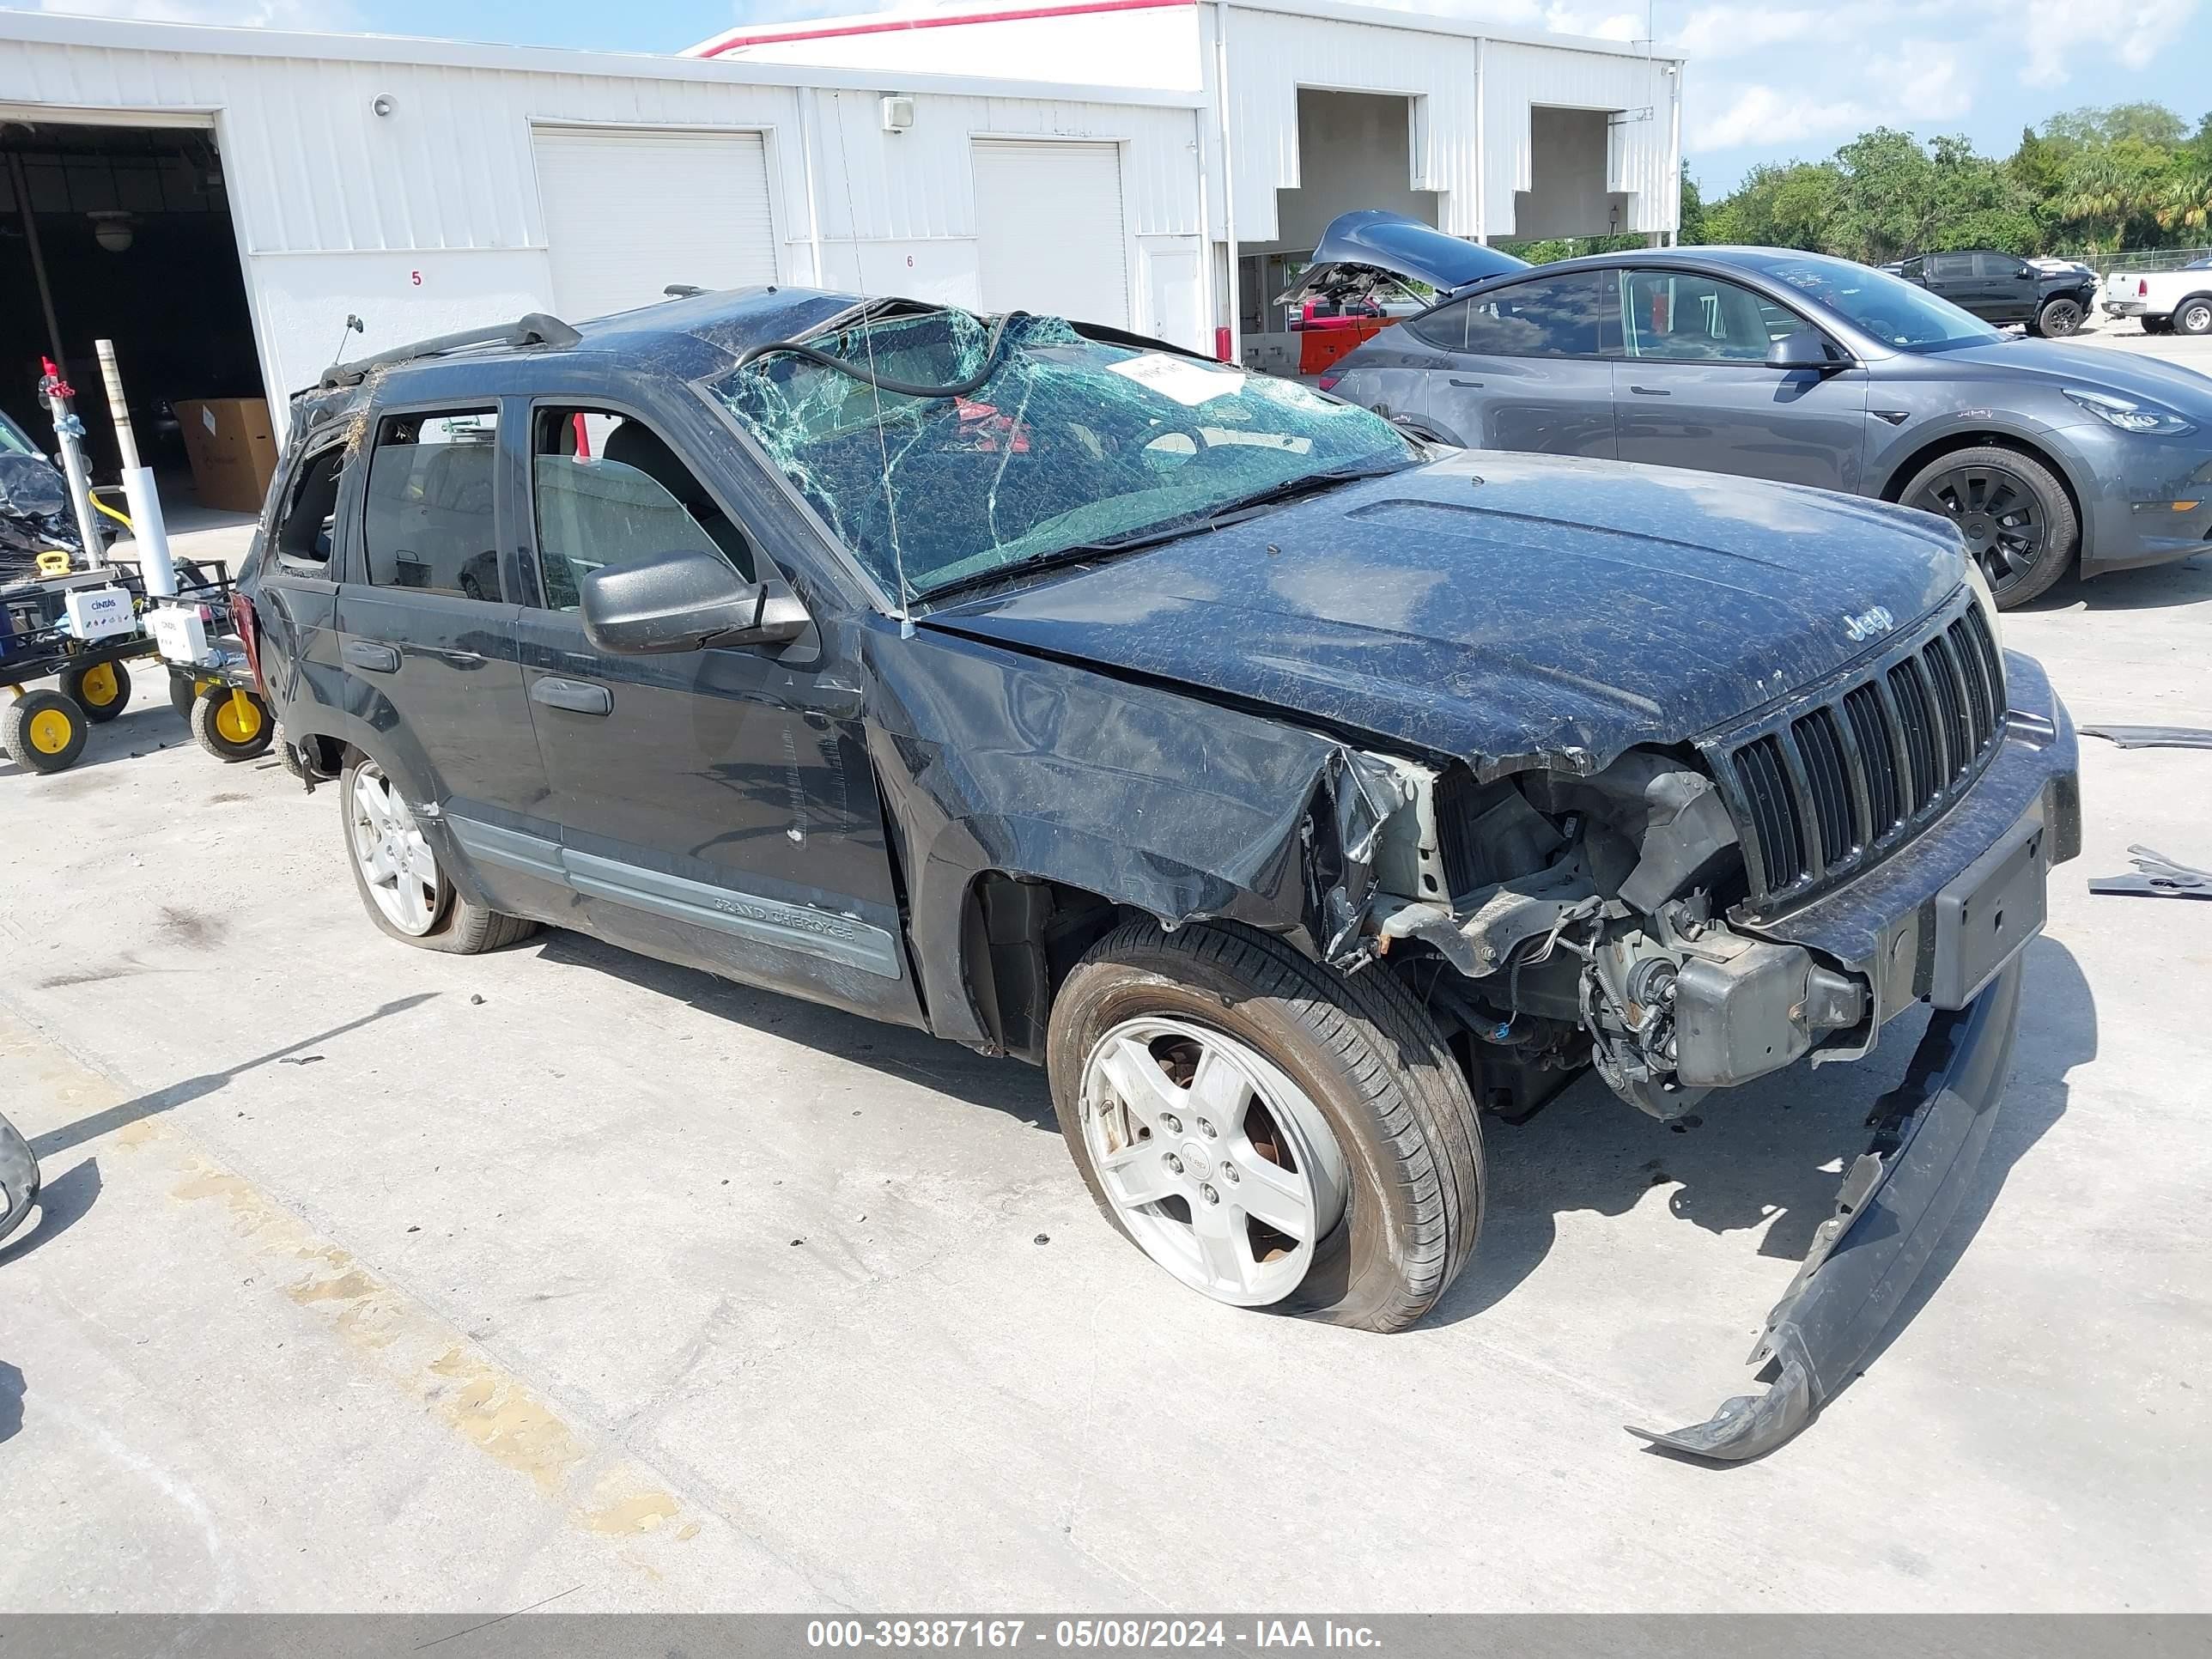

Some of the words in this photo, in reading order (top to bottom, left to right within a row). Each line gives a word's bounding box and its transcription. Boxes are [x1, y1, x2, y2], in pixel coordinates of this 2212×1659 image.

[907, 255, 914, 267] 6
[412, 270, 422, 285] 5
[91, 599, 116, 611] CINTAS
[1843, 605, 1894, 641] Jeep
[714, 897, 769, 920] GRAND
[771, 910, 857, 941] CHEROKEE
